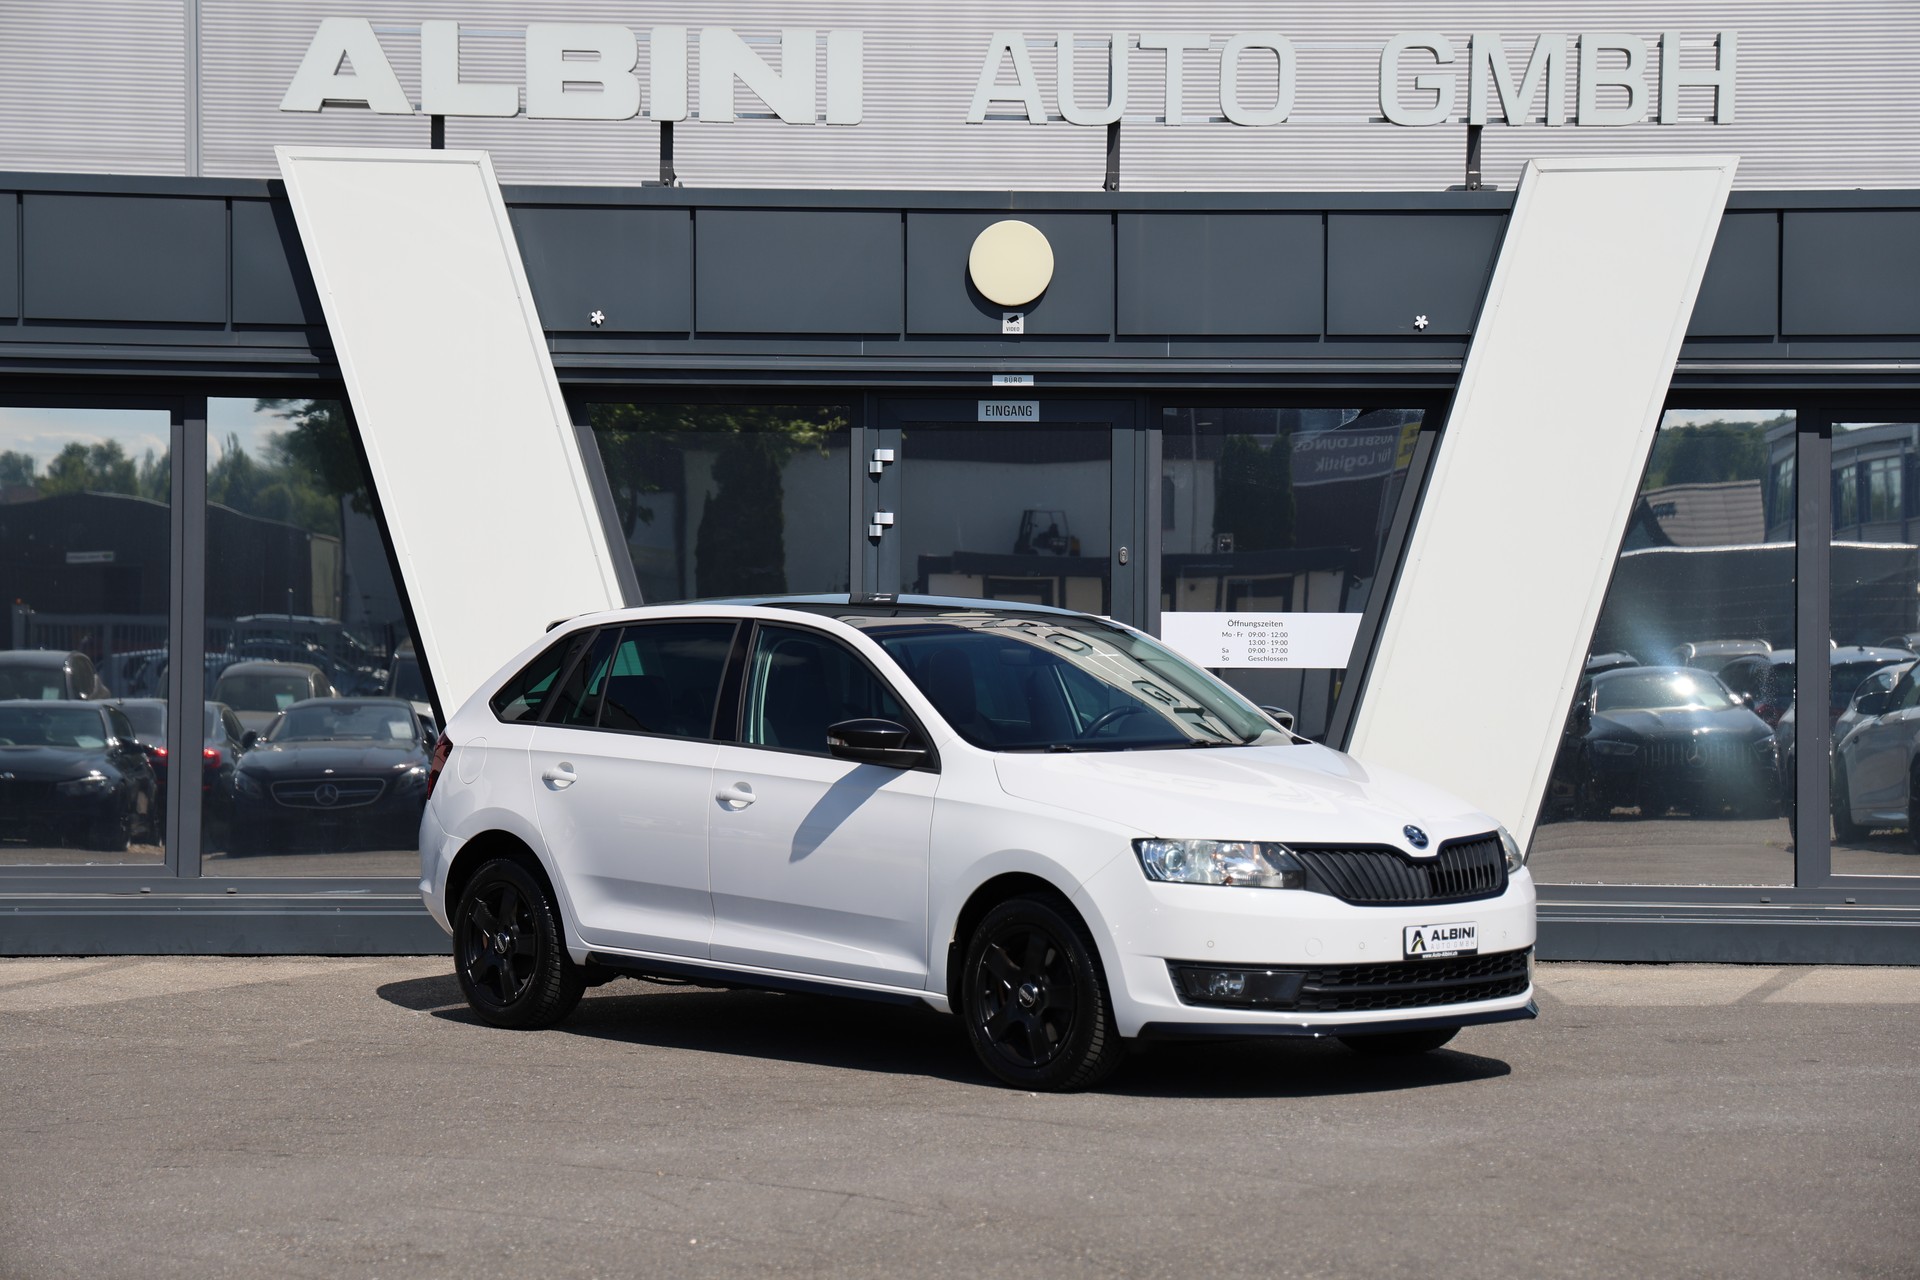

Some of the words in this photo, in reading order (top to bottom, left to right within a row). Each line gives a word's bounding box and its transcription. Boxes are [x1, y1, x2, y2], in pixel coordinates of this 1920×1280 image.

[279, 17, 864, 126] ALBINI
[965, 31, 1297, 127] AUTO
[1378, 30, 1739, 127] GMBH
[985, 405, 1033, 417] EINGANG
[1227, 619, 1283, 628] Öffnungszeiten
[1431, 926, 1475, 941] ALBINI
[1431, 942, 1451, 950] AUTO
